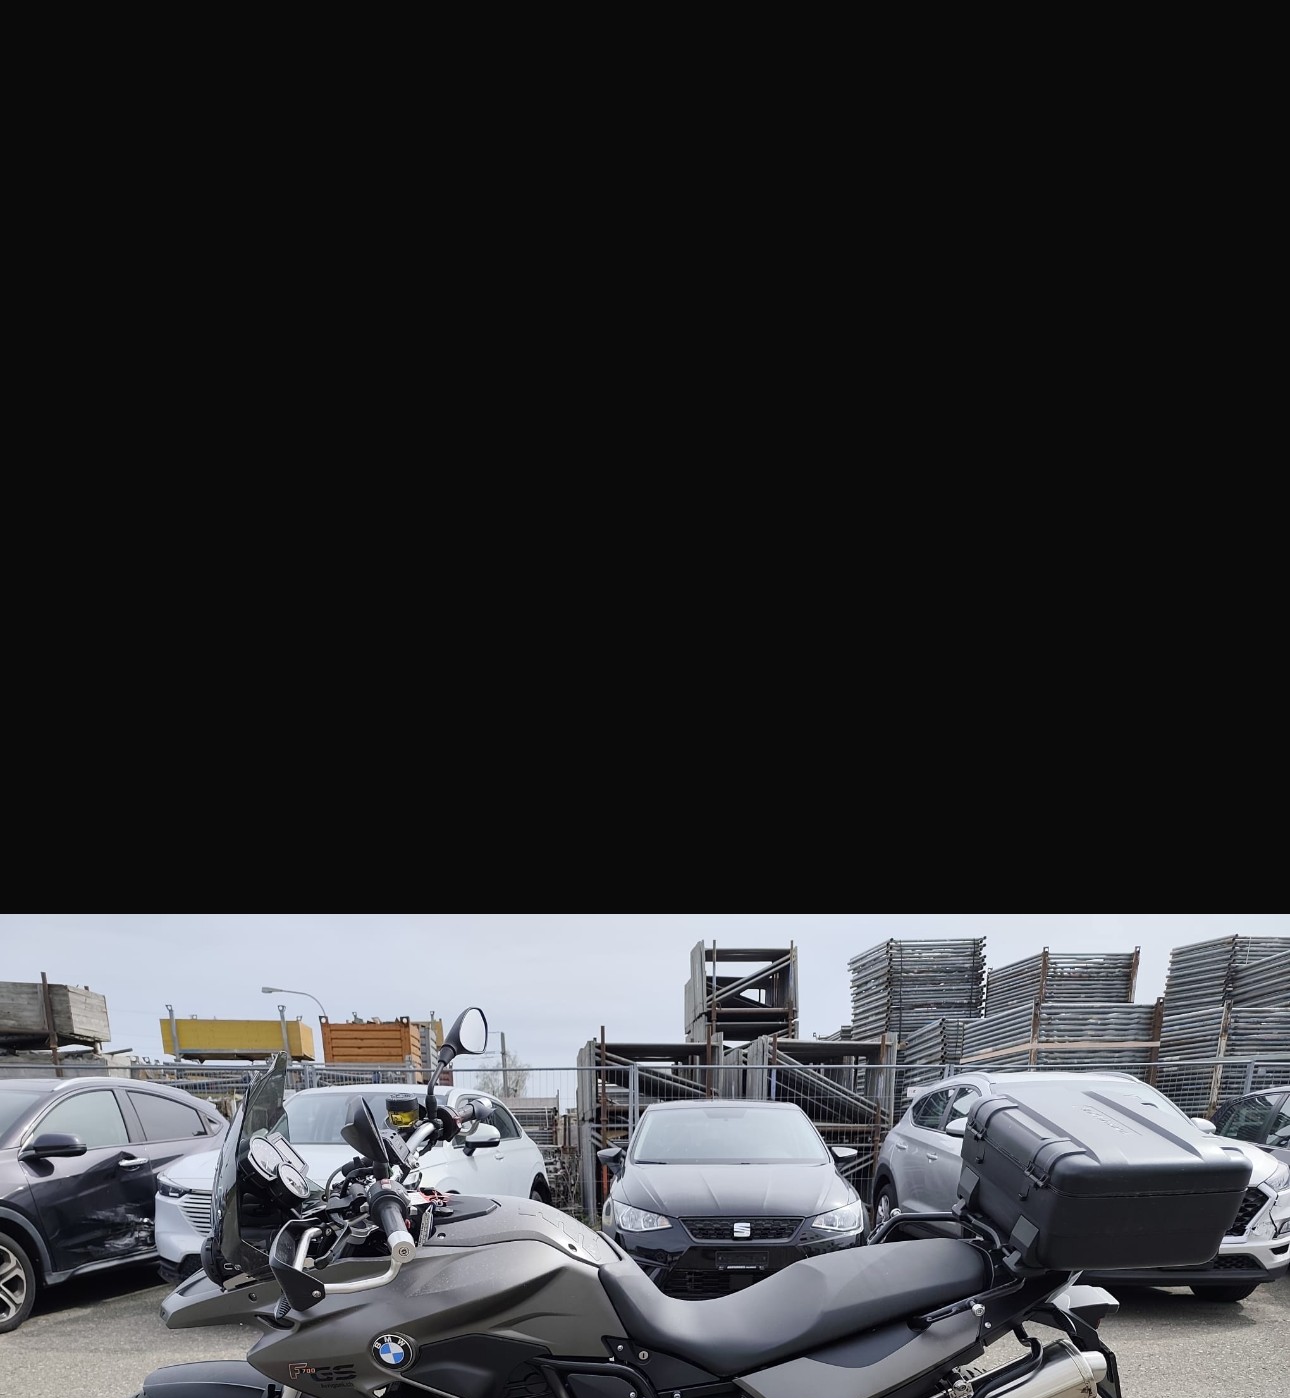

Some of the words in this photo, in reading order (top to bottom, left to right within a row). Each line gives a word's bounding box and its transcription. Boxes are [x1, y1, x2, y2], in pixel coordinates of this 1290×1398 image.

[374, 1336, 406, 1349] BMW
[288, 1362, 307, 1379] F
[311, 1363, 357, 1381] GS
